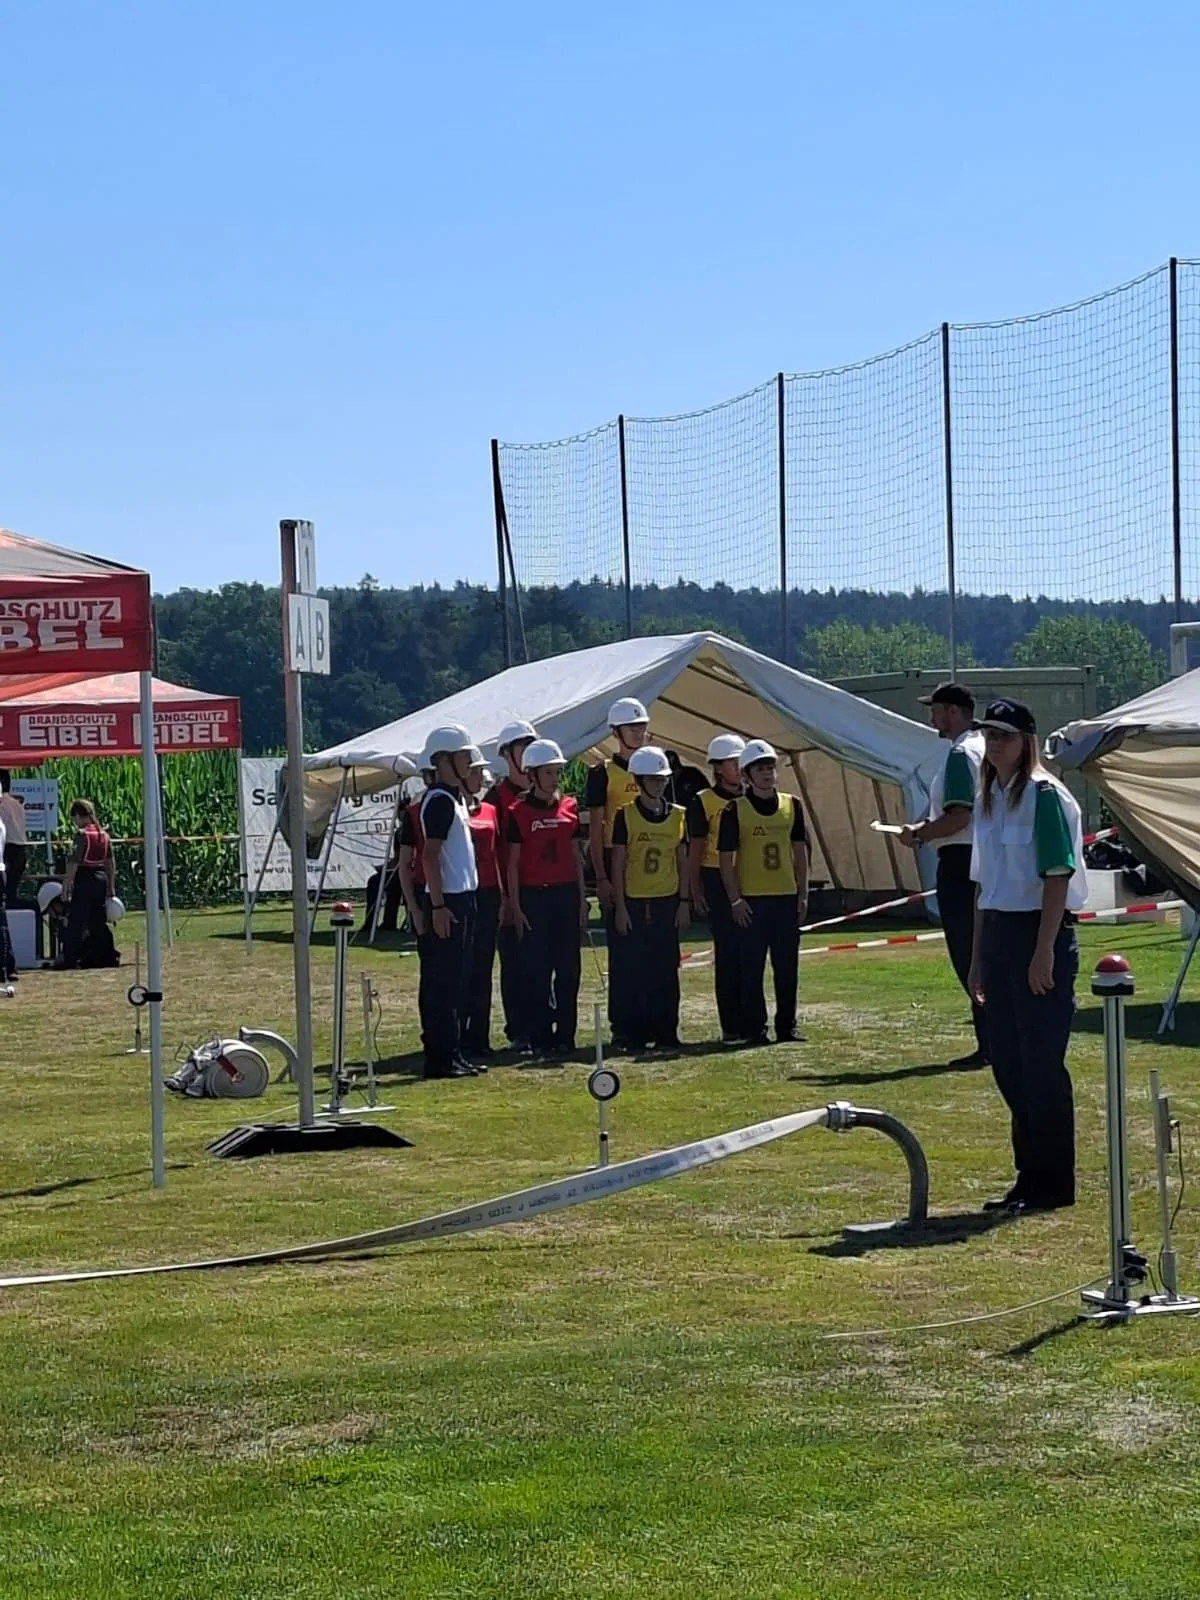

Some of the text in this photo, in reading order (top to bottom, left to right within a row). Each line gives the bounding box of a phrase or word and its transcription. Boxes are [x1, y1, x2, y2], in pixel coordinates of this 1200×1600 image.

[295, 606, 325, 662] A B
[20, 714, 118, 747] EIBEL
[28, 714, 114, 725] BRANDSCHUTZ
[644, 847, 662, 875] 6
[763, 842, 782, 871] 8
